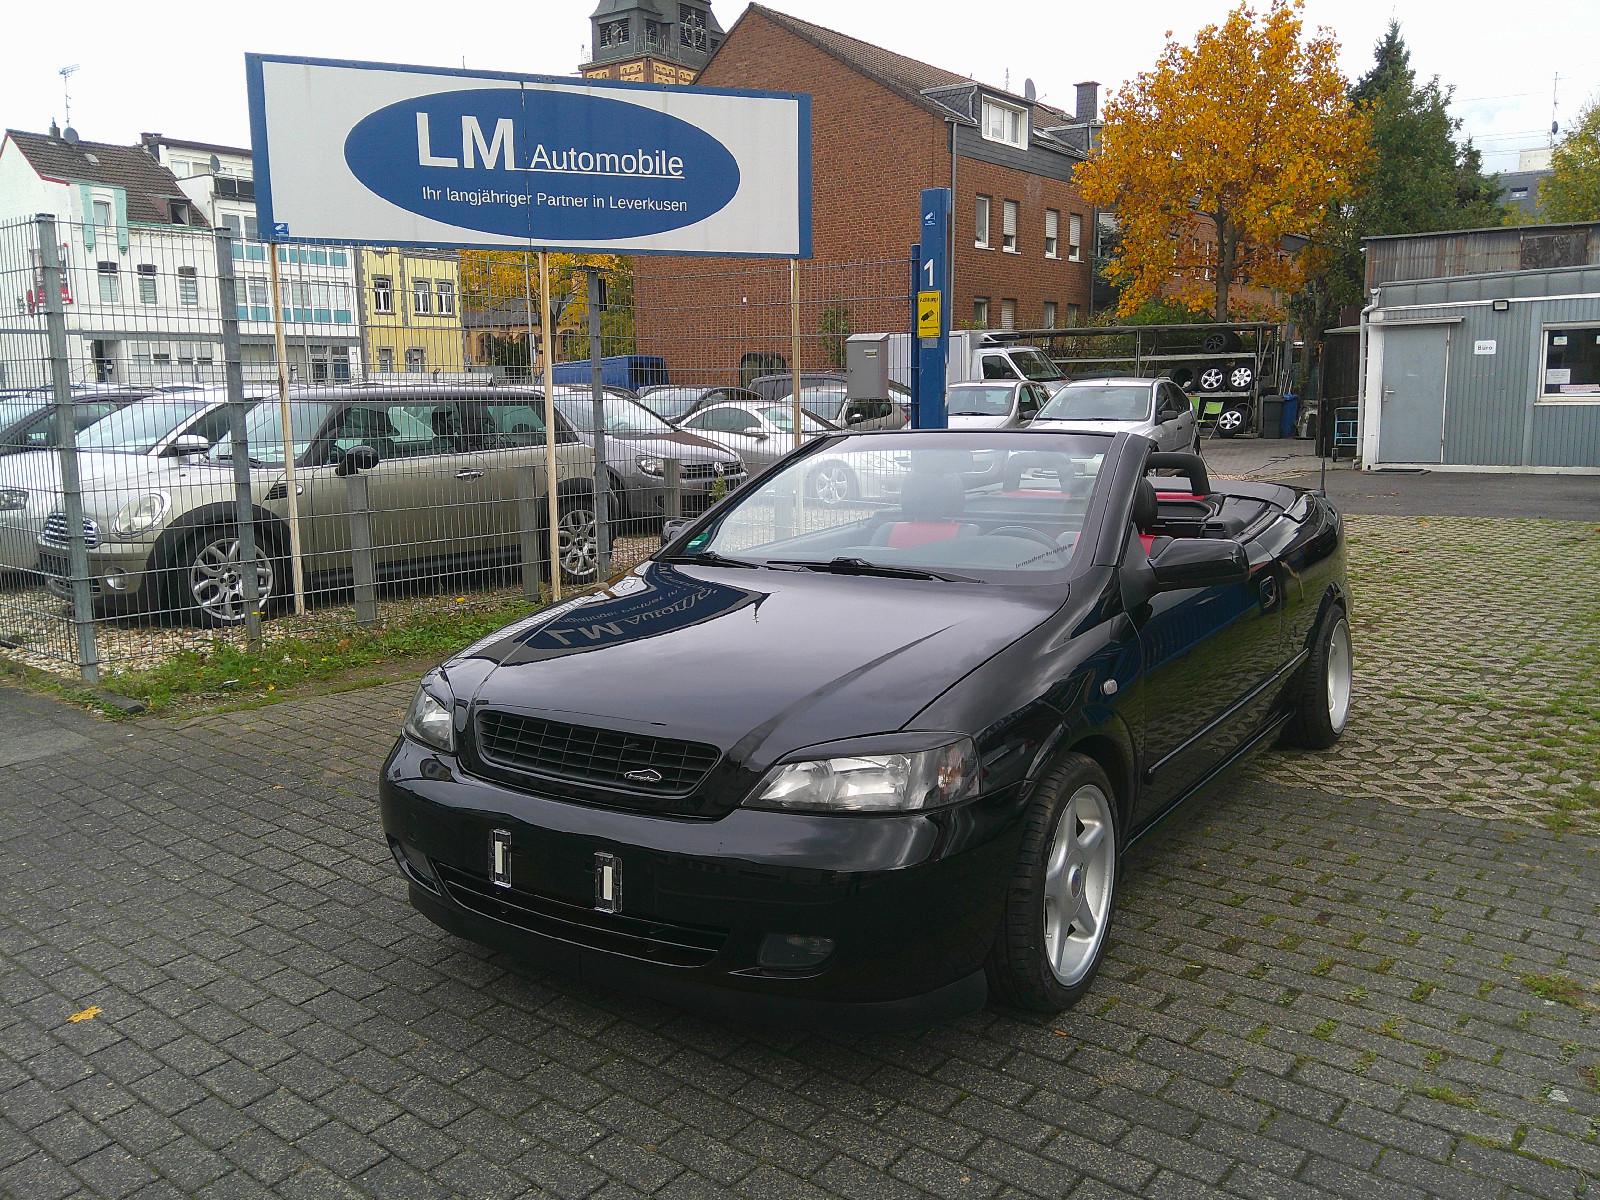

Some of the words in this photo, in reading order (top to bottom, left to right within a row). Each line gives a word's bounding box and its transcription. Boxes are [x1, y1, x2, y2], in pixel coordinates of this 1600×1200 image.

[416, 112, 515, 170] LM
[530, 144, 684, 176] Automobile
[422, 186, 441, 200] Ihr
[447, 187, 532, 208] langjähriger
[537, 193, 588, 207] Partner
[593, 194, 605, 208] in
[609, 196, 687, 211] Leverkusen
[923, 258, 934, 287] 1
